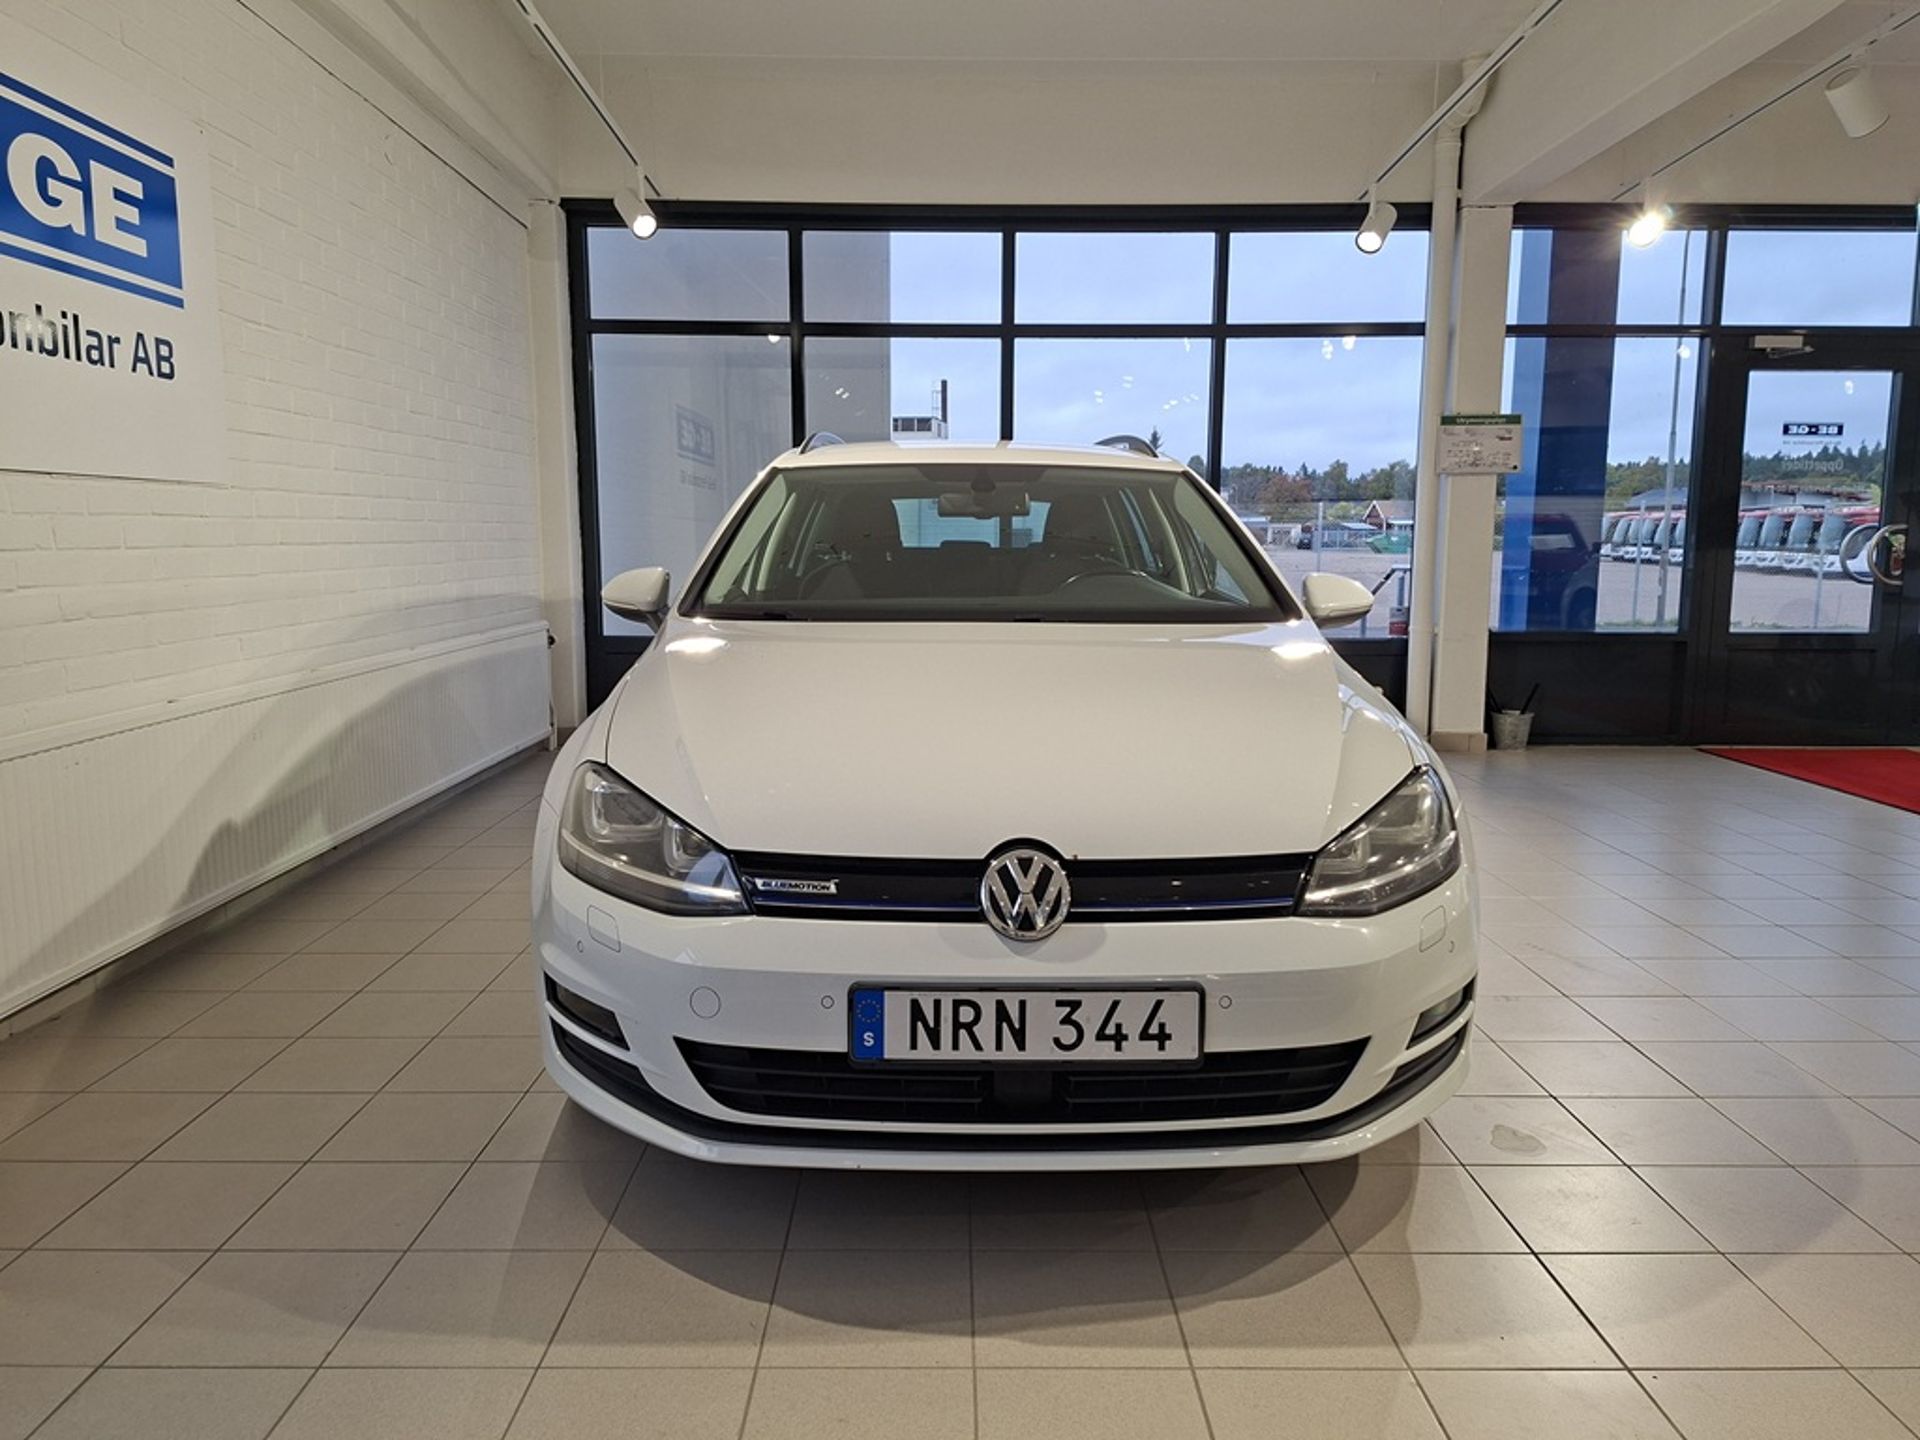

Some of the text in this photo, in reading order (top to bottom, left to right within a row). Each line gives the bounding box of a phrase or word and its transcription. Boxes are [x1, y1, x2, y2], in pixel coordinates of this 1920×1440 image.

[7, 132, 147, 258] GE
[0, 304, 175, 381] nbilar AB
[761, 880, 831, 892] BLUEMOTION
[863, 1032, 874, 1047] S
[909, 998, 1172, 1052] NRN 344
